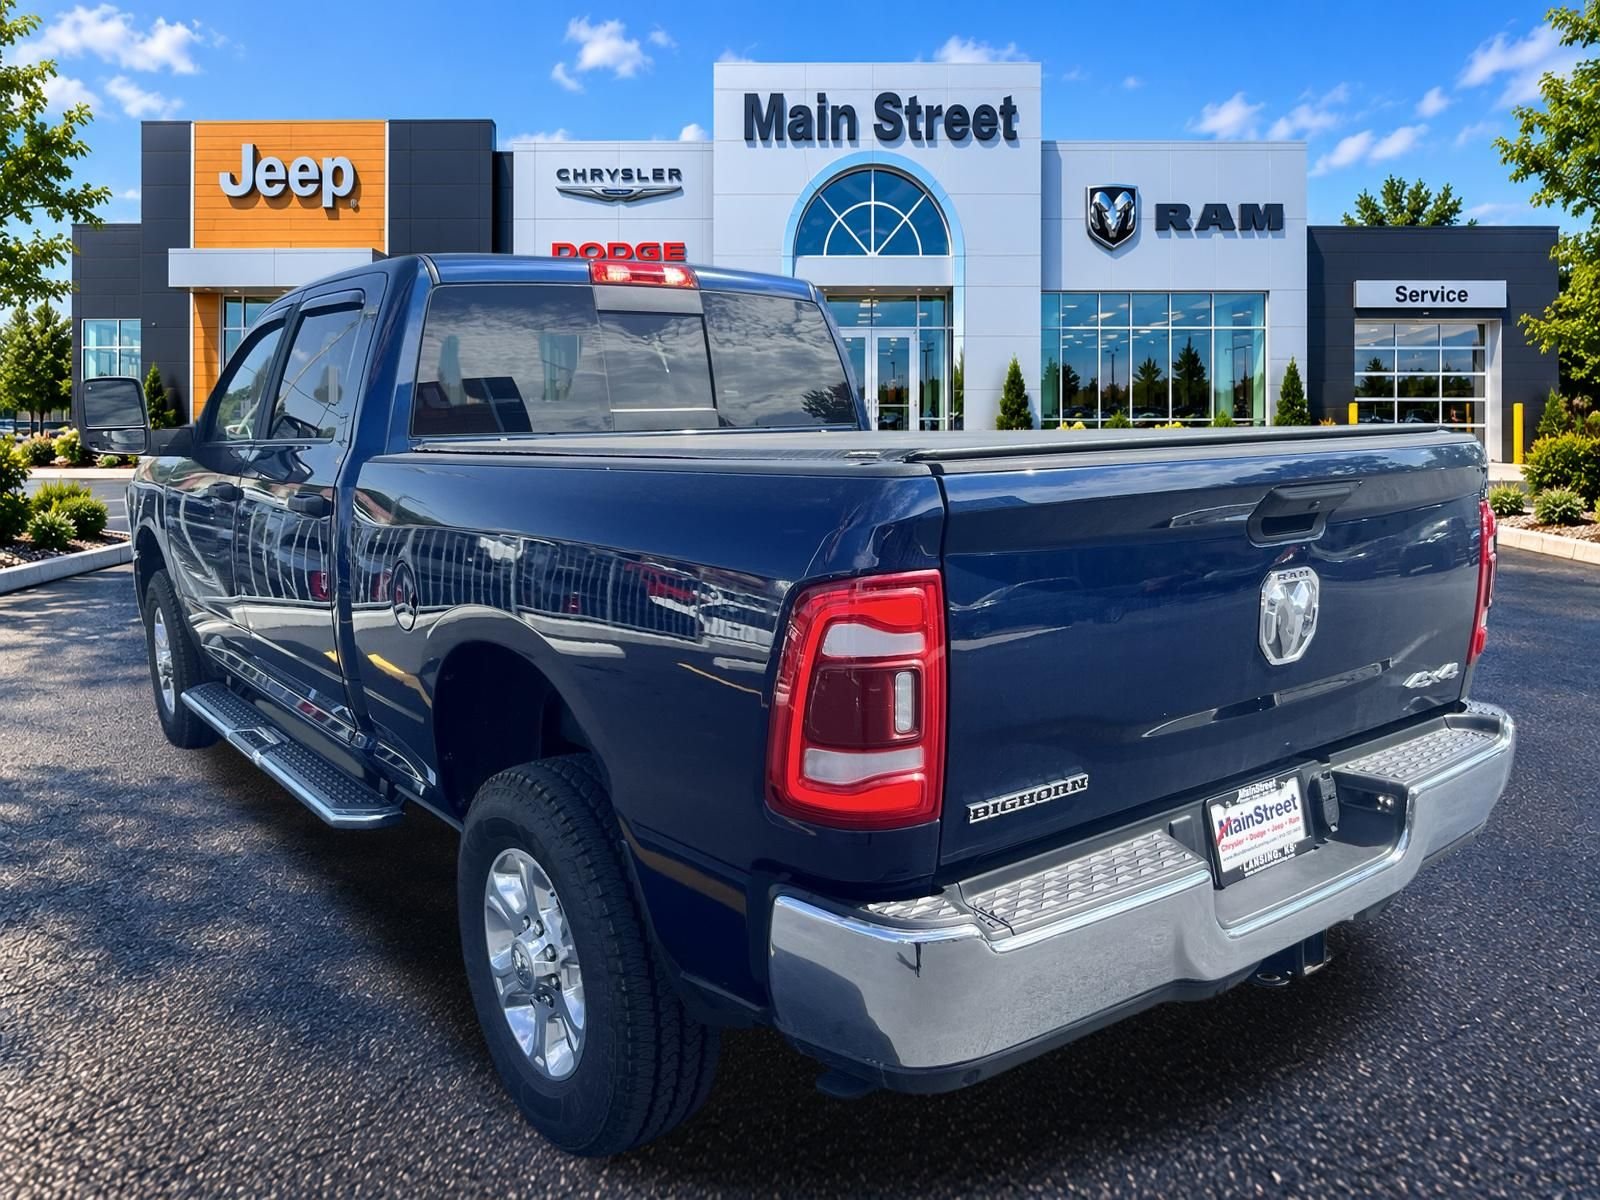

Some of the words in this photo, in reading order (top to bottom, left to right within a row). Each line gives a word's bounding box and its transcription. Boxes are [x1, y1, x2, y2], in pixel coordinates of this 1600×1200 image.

[744, 92, 857, 141] Main
[873, 91, 1018, 141] Street
[218, 143, 355, 208] Jeep
[556, 168, 682, 183] CHRYSLER
[1155, 203, 1284, 232] RAM
[551, 242, 688, 262] DODGE
[1395, 285, 1469, 303] Service
[1277, 569, 1309, 581] RAM
[967, 774, 1088, 823] BIGHORN
[1217, 794, 1298, 842] MainStreet
[1221, 837, 1244, 853] Chrysler
[1249, 829, 1267, 841] Dodge
[1271, 822, 1284, 833] Jeep
[1288, 815, 1300, 825] Ram
